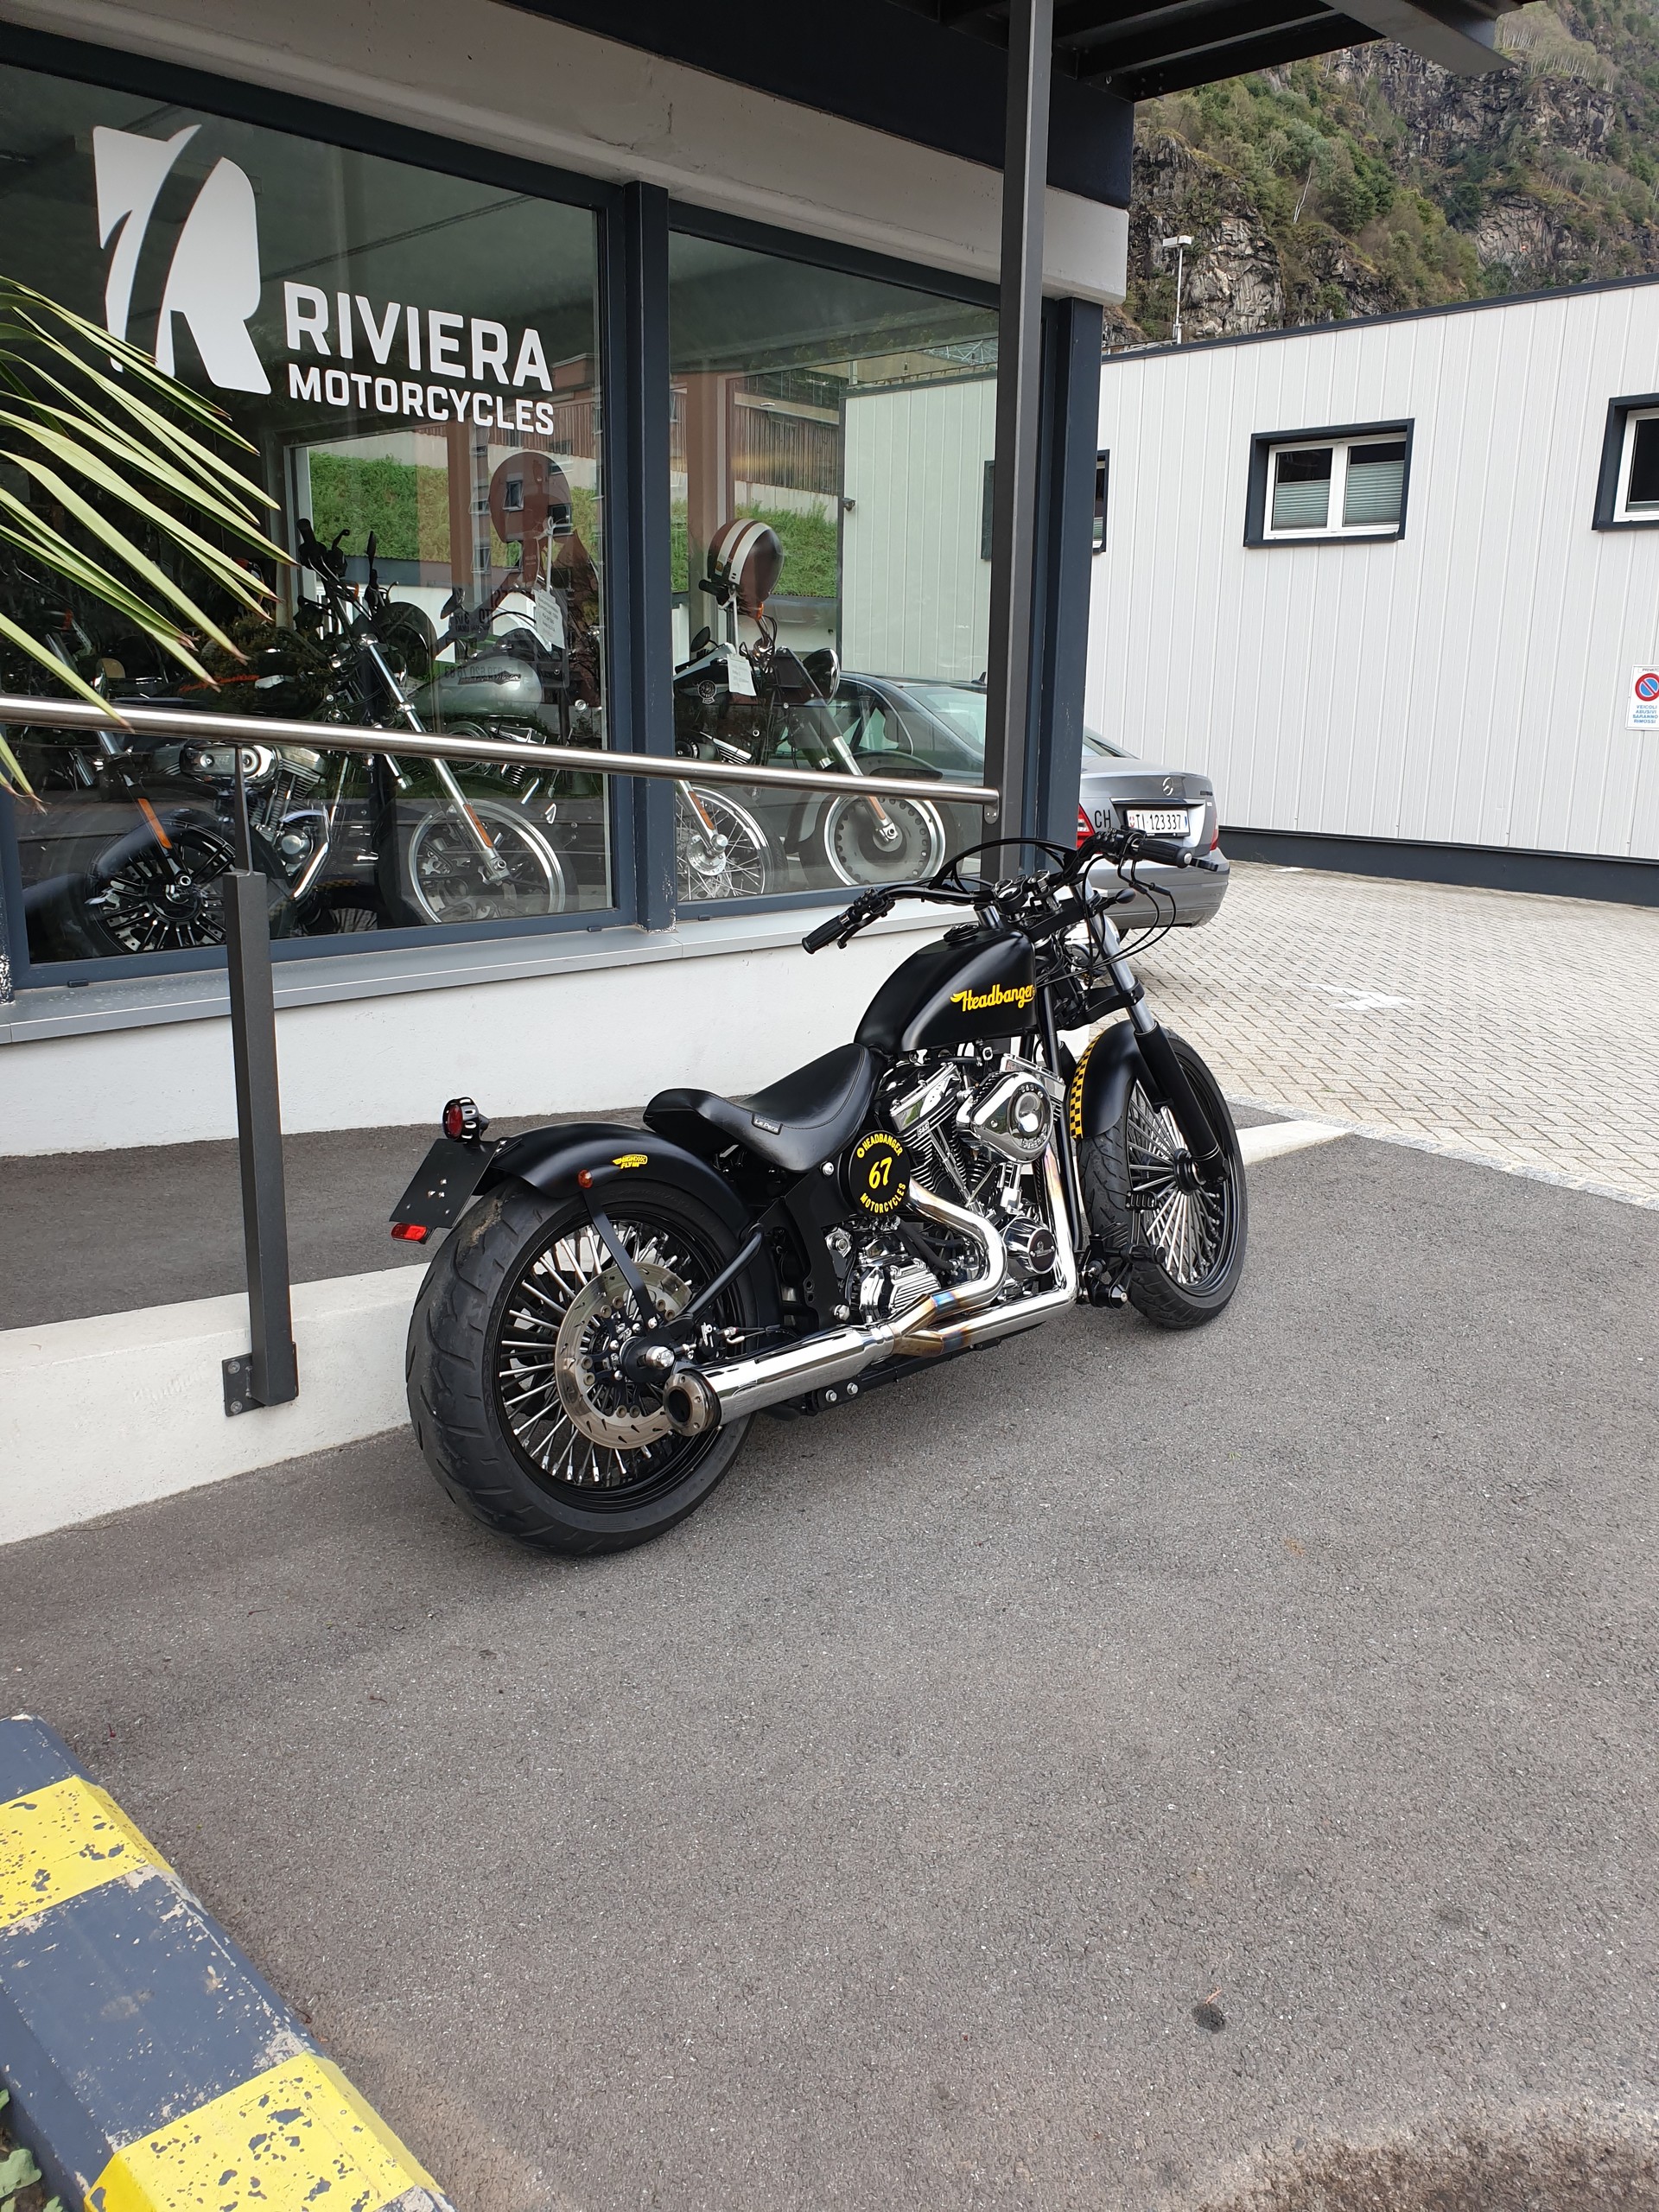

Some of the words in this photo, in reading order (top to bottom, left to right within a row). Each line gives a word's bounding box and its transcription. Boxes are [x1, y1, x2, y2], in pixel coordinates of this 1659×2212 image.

[283, 281, 553, 392] RIVIERA
[288, 363, 554, 435] MOTORCYCLES
[1094, 810, 1111, 829] CH
[950, 983, 1034, 1012] Headbanger
[763, 1122, 779, 1132] Pera
[861, 1133, 904, 1157] HEADBANGER
[868, 1156, 893, 1189] 67
[860, 1182, 906, 1214] MOTORCYCLES
